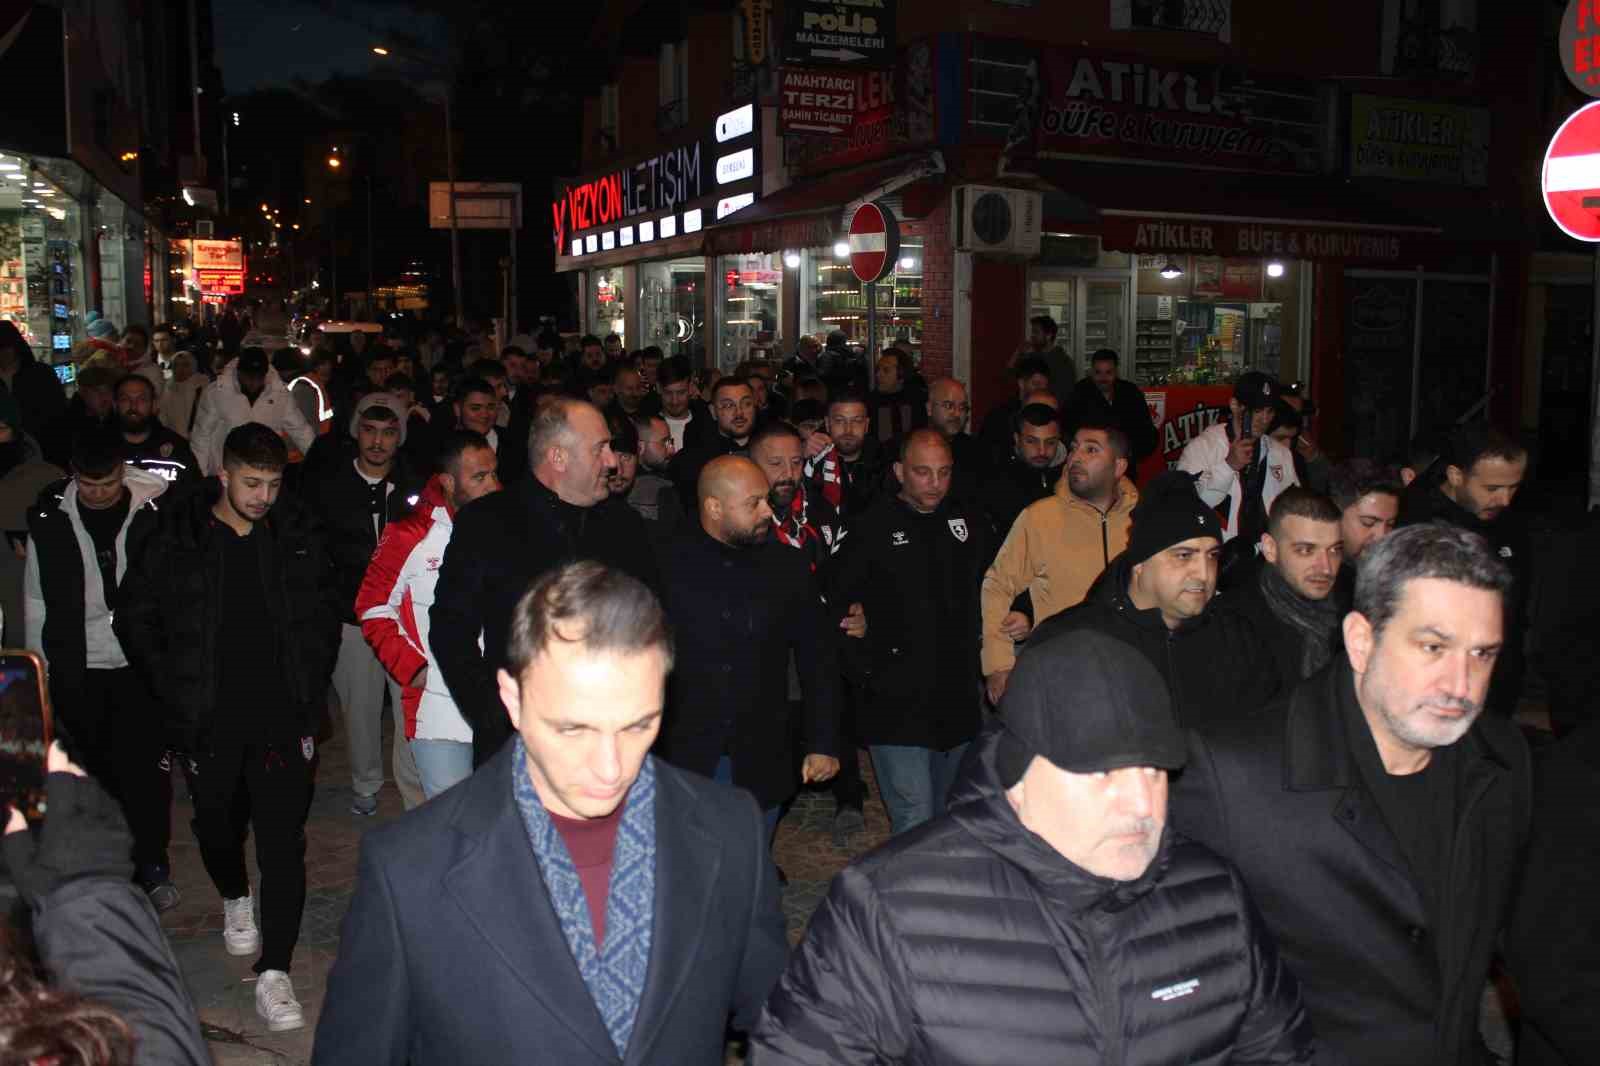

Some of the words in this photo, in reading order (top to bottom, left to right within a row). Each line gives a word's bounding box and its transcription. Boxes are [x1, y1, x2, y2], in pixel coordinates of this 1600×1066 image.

[795, 32, 886, 49] MALZEMELERİ
[784, 73, 855, 91] ANAHTARCI
[783, 91, 855, 110] TERZİ
[1135, 221, 1215, 250] ATİKLER
[1236, 224, 1282, 252] BÜFE
